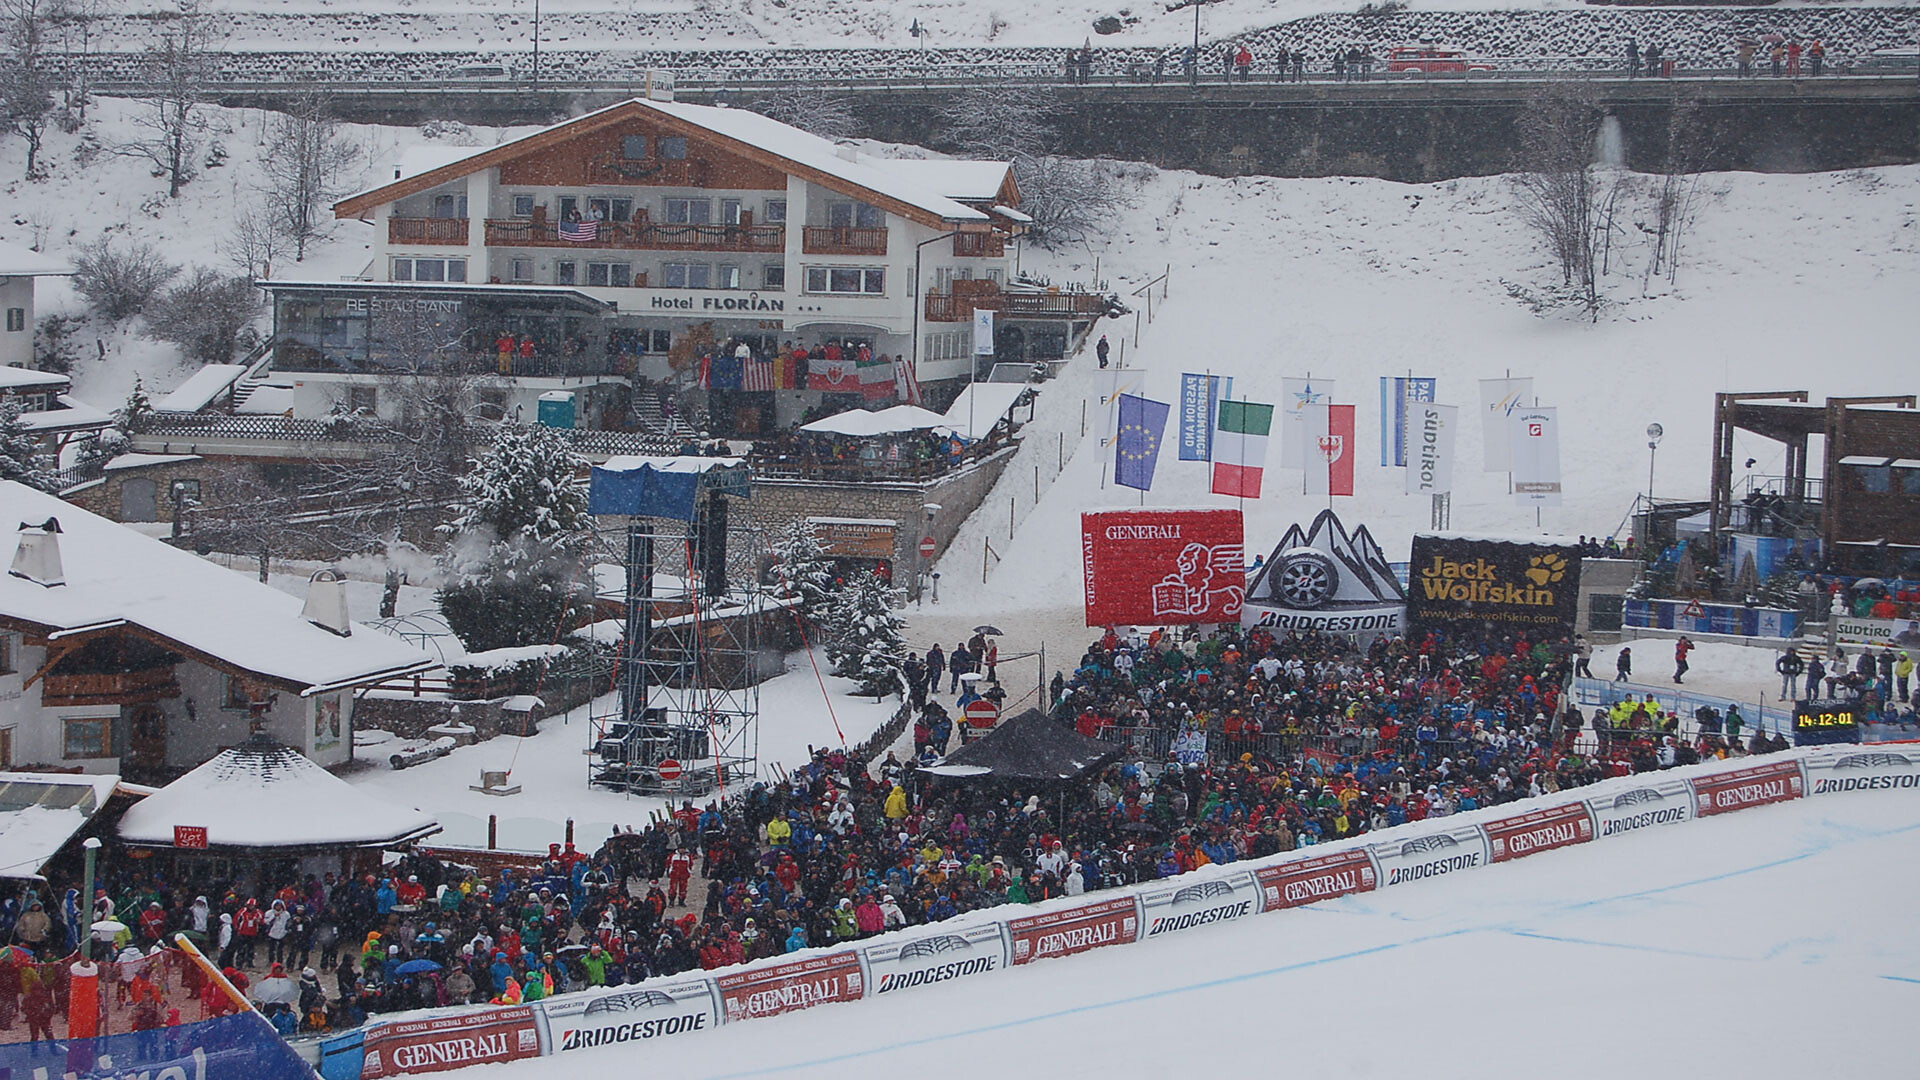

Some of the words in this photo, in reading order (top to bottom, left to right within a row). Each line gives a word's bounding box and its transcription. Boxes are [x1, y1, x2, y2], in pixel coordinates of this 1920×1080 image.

[346, 298, 462, 313] RESTAURANT
[651, 296, 693, 310] Hotel
[703, 292, 784, 311] FLORIAN
[1105, 524, 1182, 541] GENERALI
[1083, 532, 1096, 606] GENERALI
[1422, 556, 1497, 581] Jack
[1421, 577, 1555, 606] Wolfskin
[1259, 611, 1399, 631] BRIDGESTONE
[1419, 610, 1560, 624] www.jack-wolfskin.com
[1798, 712, 1853, 727] 14:12:01
[1716, 780, 1785, 808] GENERALI
[1602, 805, 1686, 836] BRIDGESTONE
[1509, 822, 1576, 853] GENERALI
[1388, 852, 1480, 886] BRIDGESTONE
[1285, 870, 1357, 902] GENERALI
[1148, 900, 1252, 936] BRIDGESTONE
[1037, 922, 1117, 955] GENERALI
[877, 955, 998, 994] BRIDGESTONE
[748, 977, 840, 1014] GENERALI
[396, 1022, 428, 1033] GENERALI
[432, 1018, 462, 1029] GENERALI
[465, 1013, 497, 1024] GENERALI
[500, 1008, 531, 1019] GENERALI
[561, 1012, 707, 1051] BRIDGESTONE
[393, 1032, 510, 1069] GENERALI
